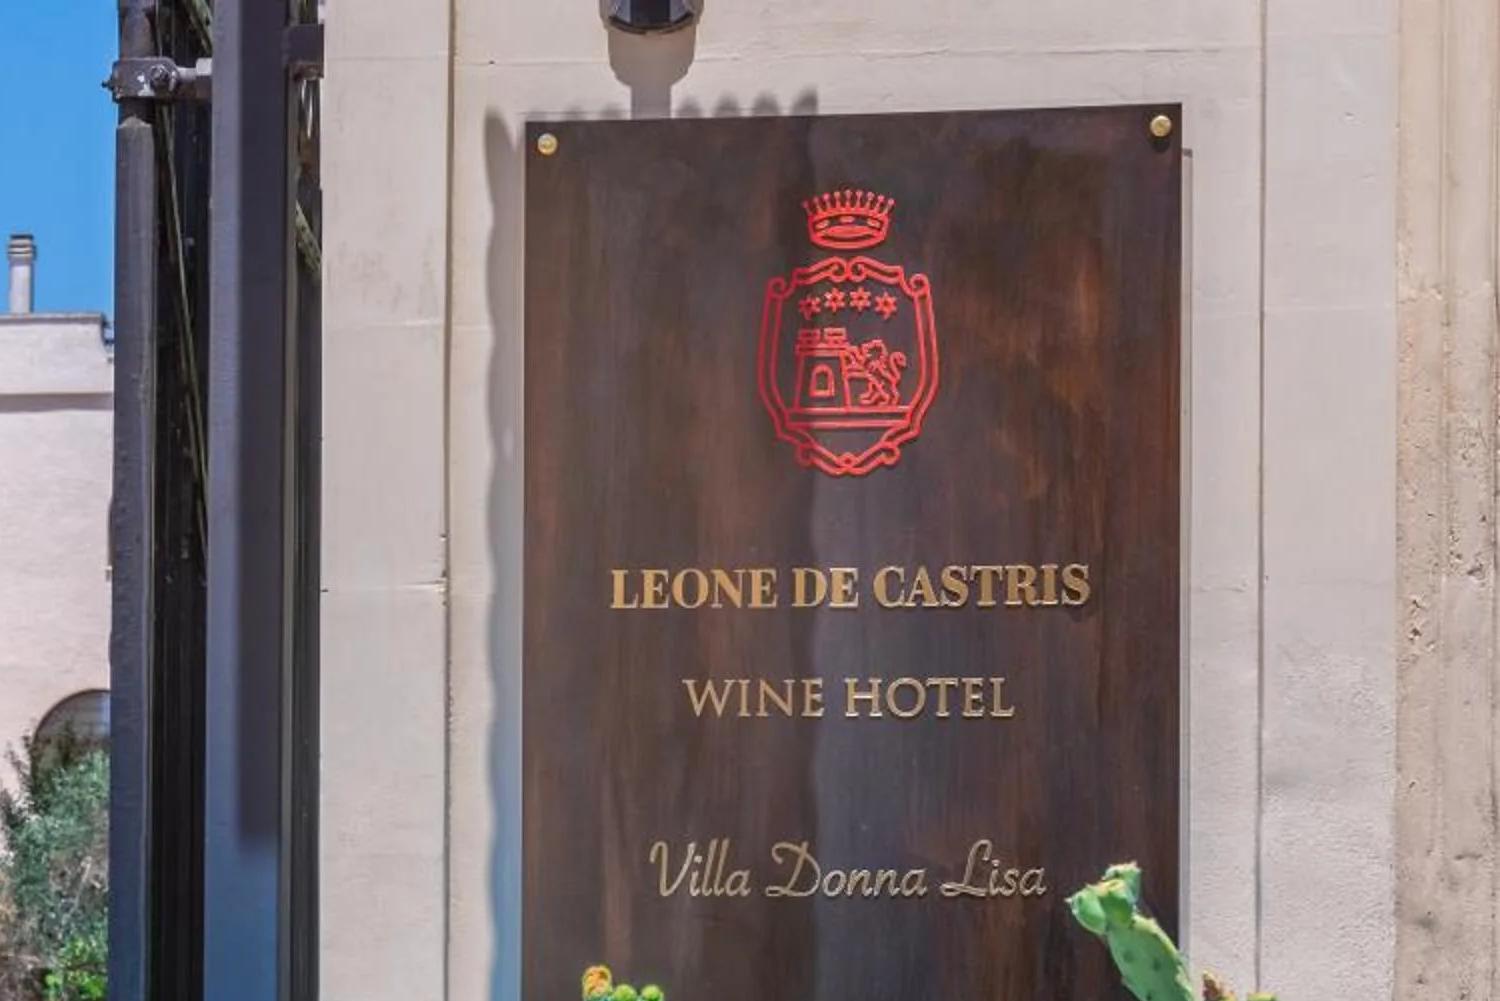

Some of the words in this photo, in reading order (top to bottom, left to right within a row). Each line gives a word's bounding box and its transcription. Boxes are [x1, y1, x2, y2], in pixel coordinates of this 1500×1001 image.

[610, 567, 778, 609] LEONE
[792, 566, 860, 608] DE
[873, 562, 1092, 608] CASTRIS
[682, 676, 825, 718] WINE
[844, 676, 1017, 718] HOTEL
[649, 838, 751, 897] Villa
[765, 840, 928, 898] Donna
[940, 839, 1047, 897] Lisa
